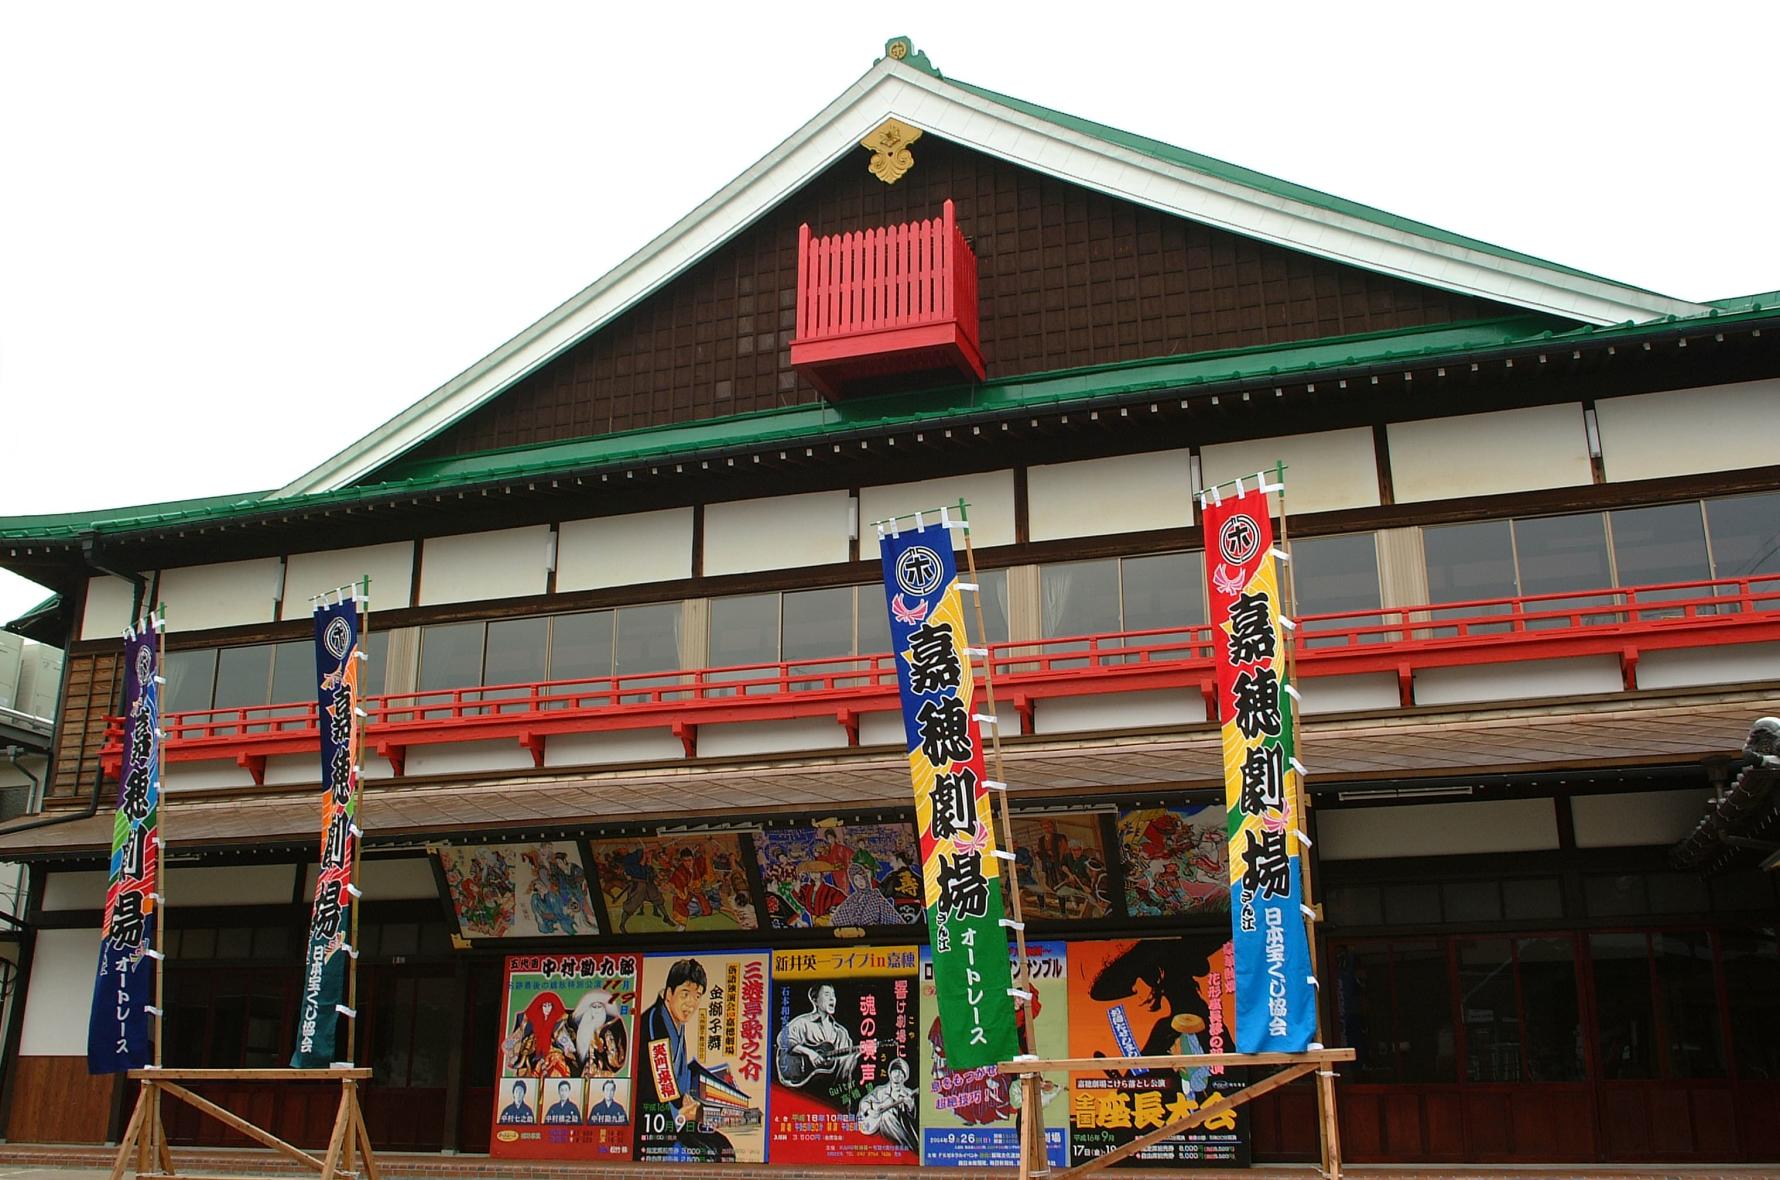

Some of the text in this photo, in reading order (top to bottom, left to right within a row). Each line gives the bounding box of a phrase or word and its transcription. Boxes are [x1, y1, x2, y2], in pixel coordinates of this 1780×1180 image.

[907, 622, 989, 921] 嘉穂劇場
[1227, 591, 1291, 900] 嘉穂劇場
[115, 957, 130, 1054] オートレース
[300, 945, 324, 1053] 日本宝くじ協会
[542, 957, 636, 978] 中村勘九郎
[708, 984, 724, 1051] 金獅子舞
[739, 961, 764, 1081] 三遊亭歌之介
[961, 927, 987, 1045] オートレース
[1264, 907, 1288, 1037] 日本宝くじ協会
[829, 1079, 856, 1097] Guitar
